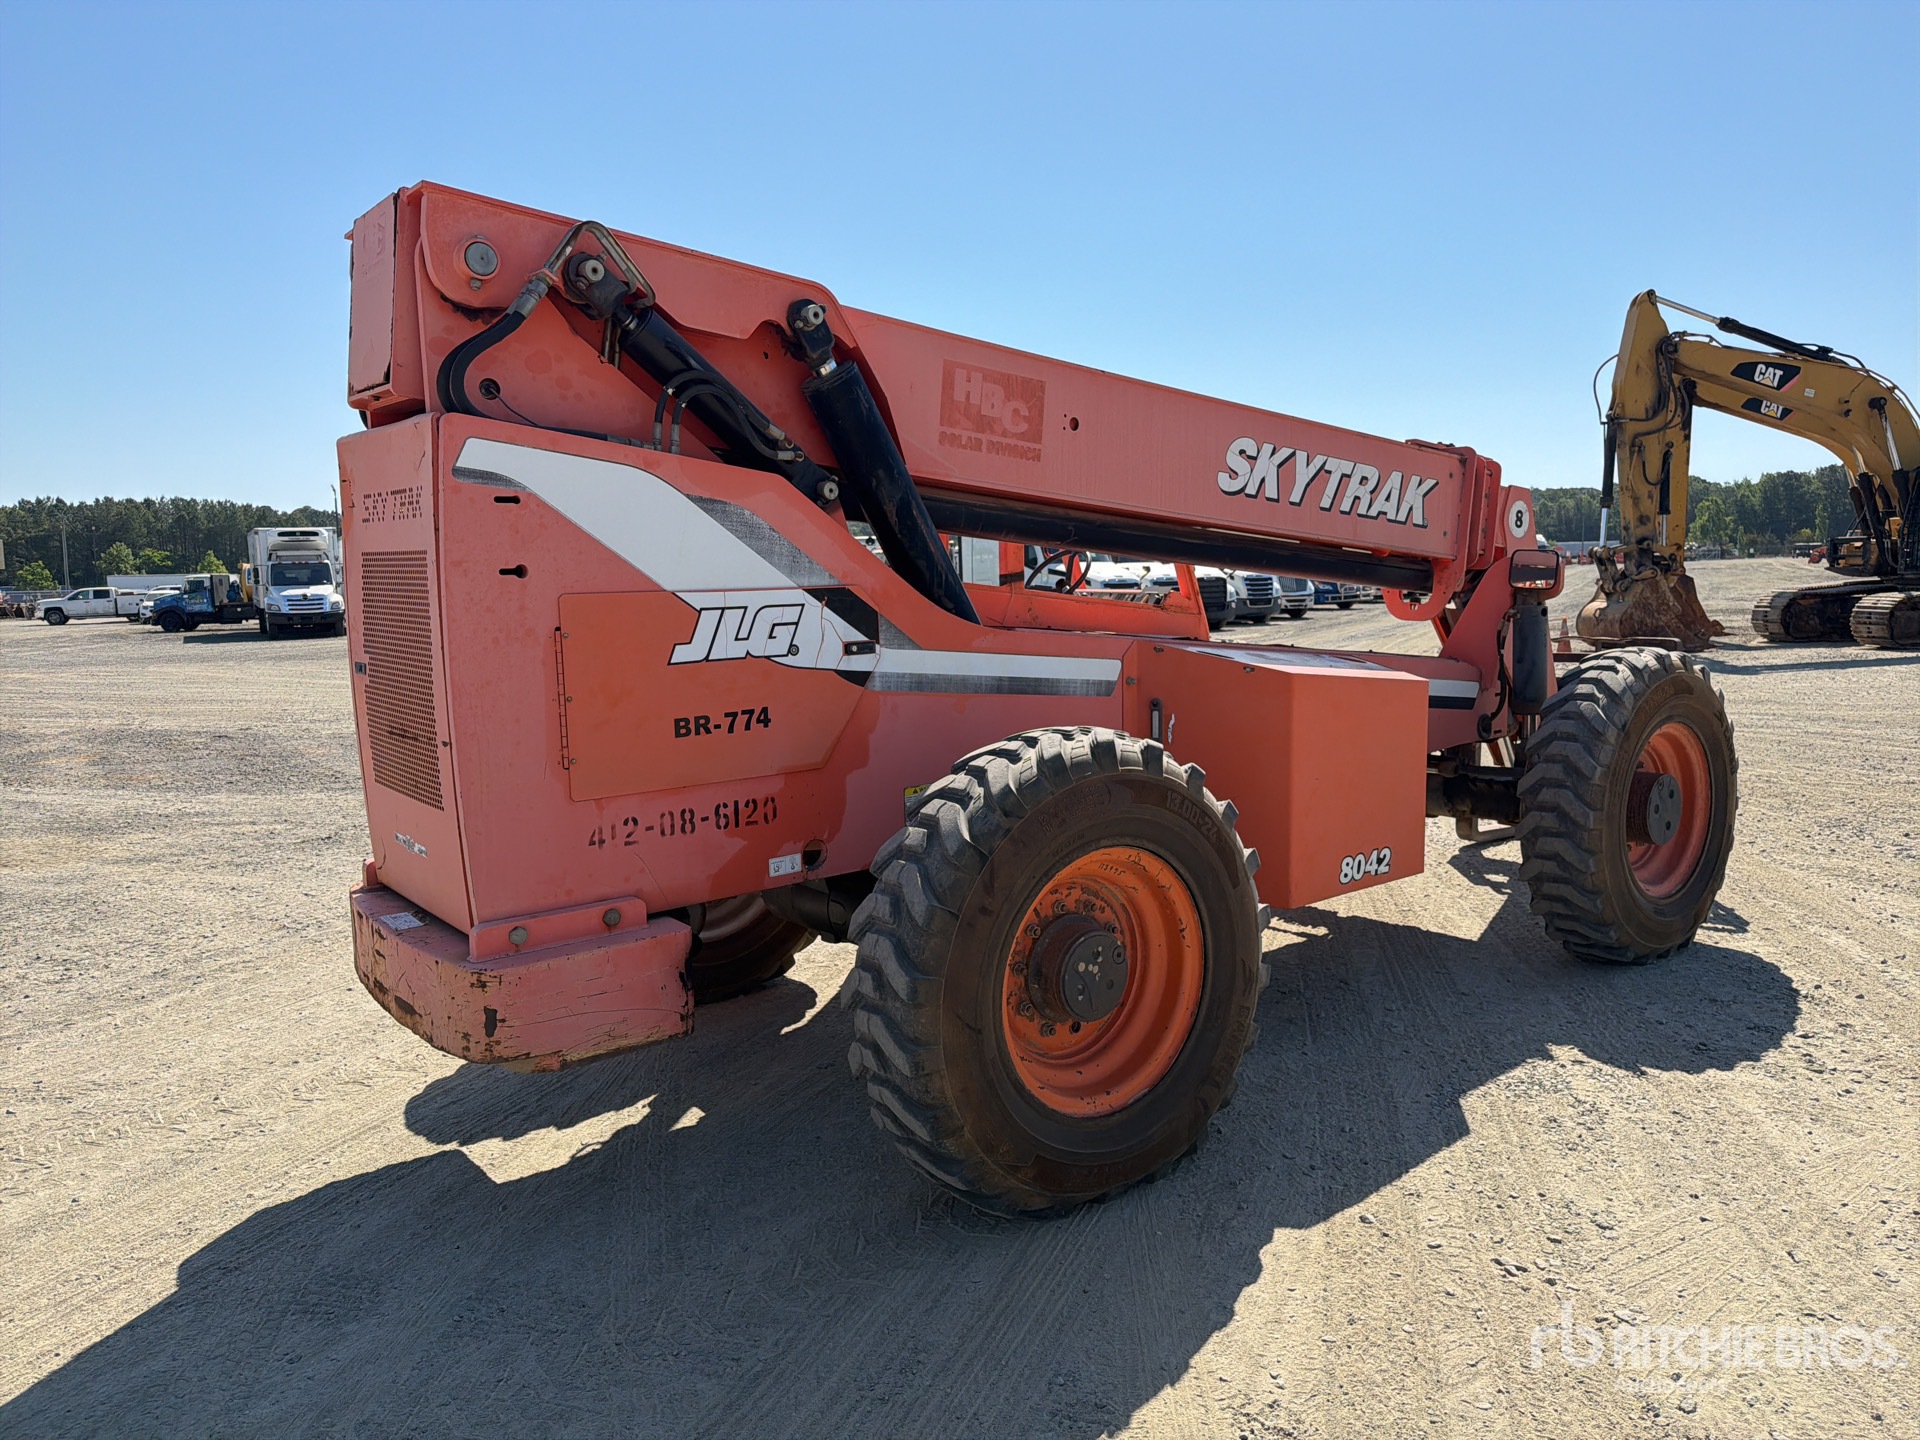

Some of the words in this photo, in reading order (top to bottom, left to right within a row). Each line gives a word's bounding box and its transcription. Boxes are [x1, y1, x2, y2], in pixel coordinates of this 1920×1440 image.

[1755, 363, 1783, 388] CAT
[953, 367, 1030, 433] HBC
[1760, 400, 1783, 419] CAT
[1217, 437, 1439, 528] SKYTRAK
[1513, 508, 1524, 530] 8
[667, 603, 805, 666] JLG
[674, 706, 772, 739] BR-774
[1339, 846, 1393, 886] 8042
